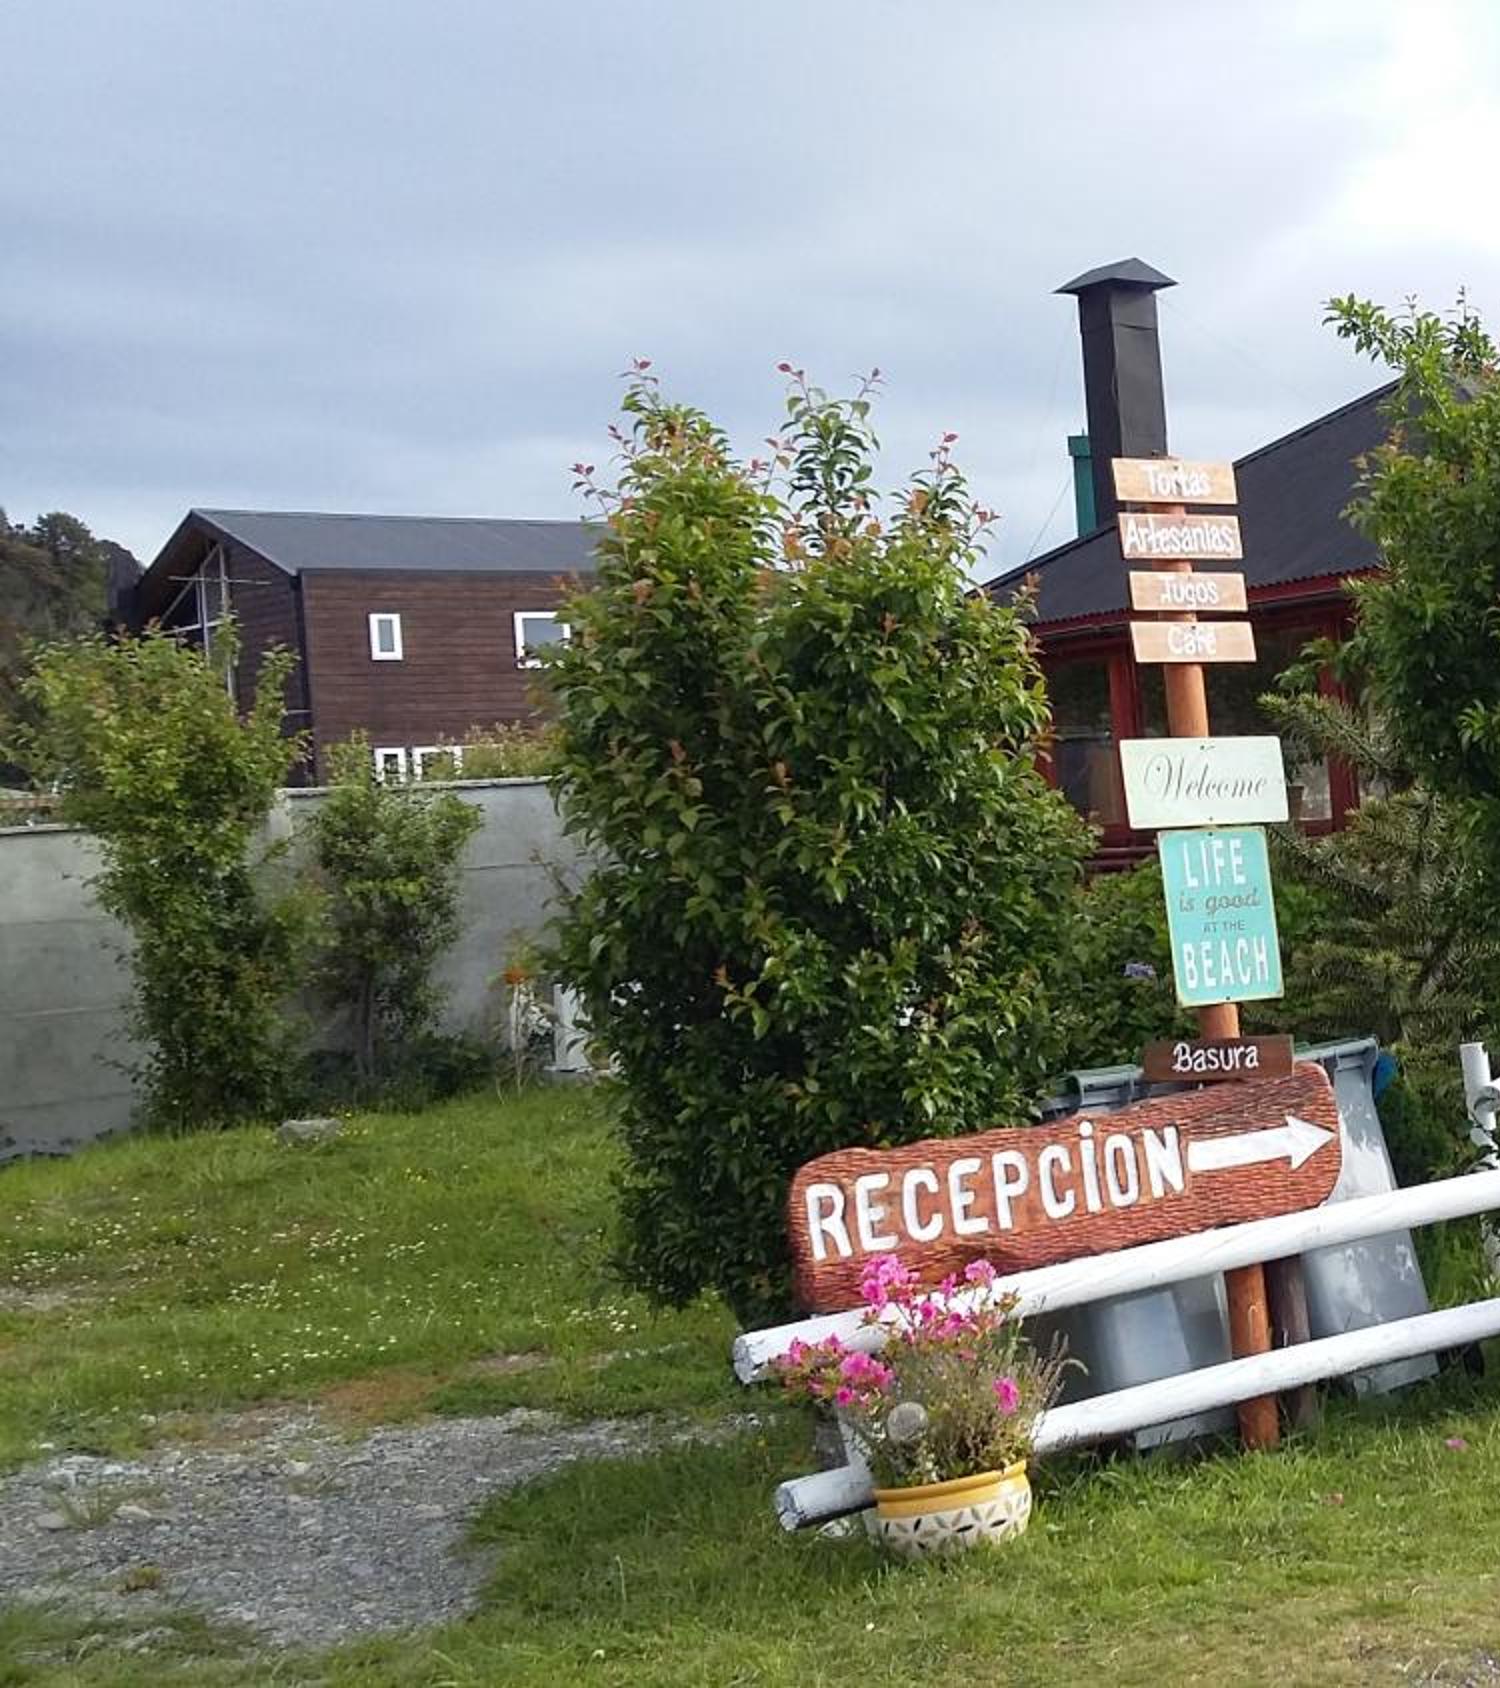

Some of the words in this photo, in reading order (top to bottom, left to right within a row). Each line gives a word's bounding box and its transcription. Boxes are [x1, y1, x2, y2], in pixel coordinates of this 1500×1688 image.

[1144, 464, 1210, 496] Tortas
[1161, 576, 1217, 607] Jugos
[1145, 756, 1267, 800] Welcome
[1184, 838, 1246, 887] LIFE
[1180, 893, 1195, 912] is
[1205, 889, 1260, 916] good
[1203, 921, 1219, 933] AT
[1223, 919, 1245, 932] THE
[1182, 937, 1269, 988] BEACH
[1172, 1042, 1258, 1072] Basura
